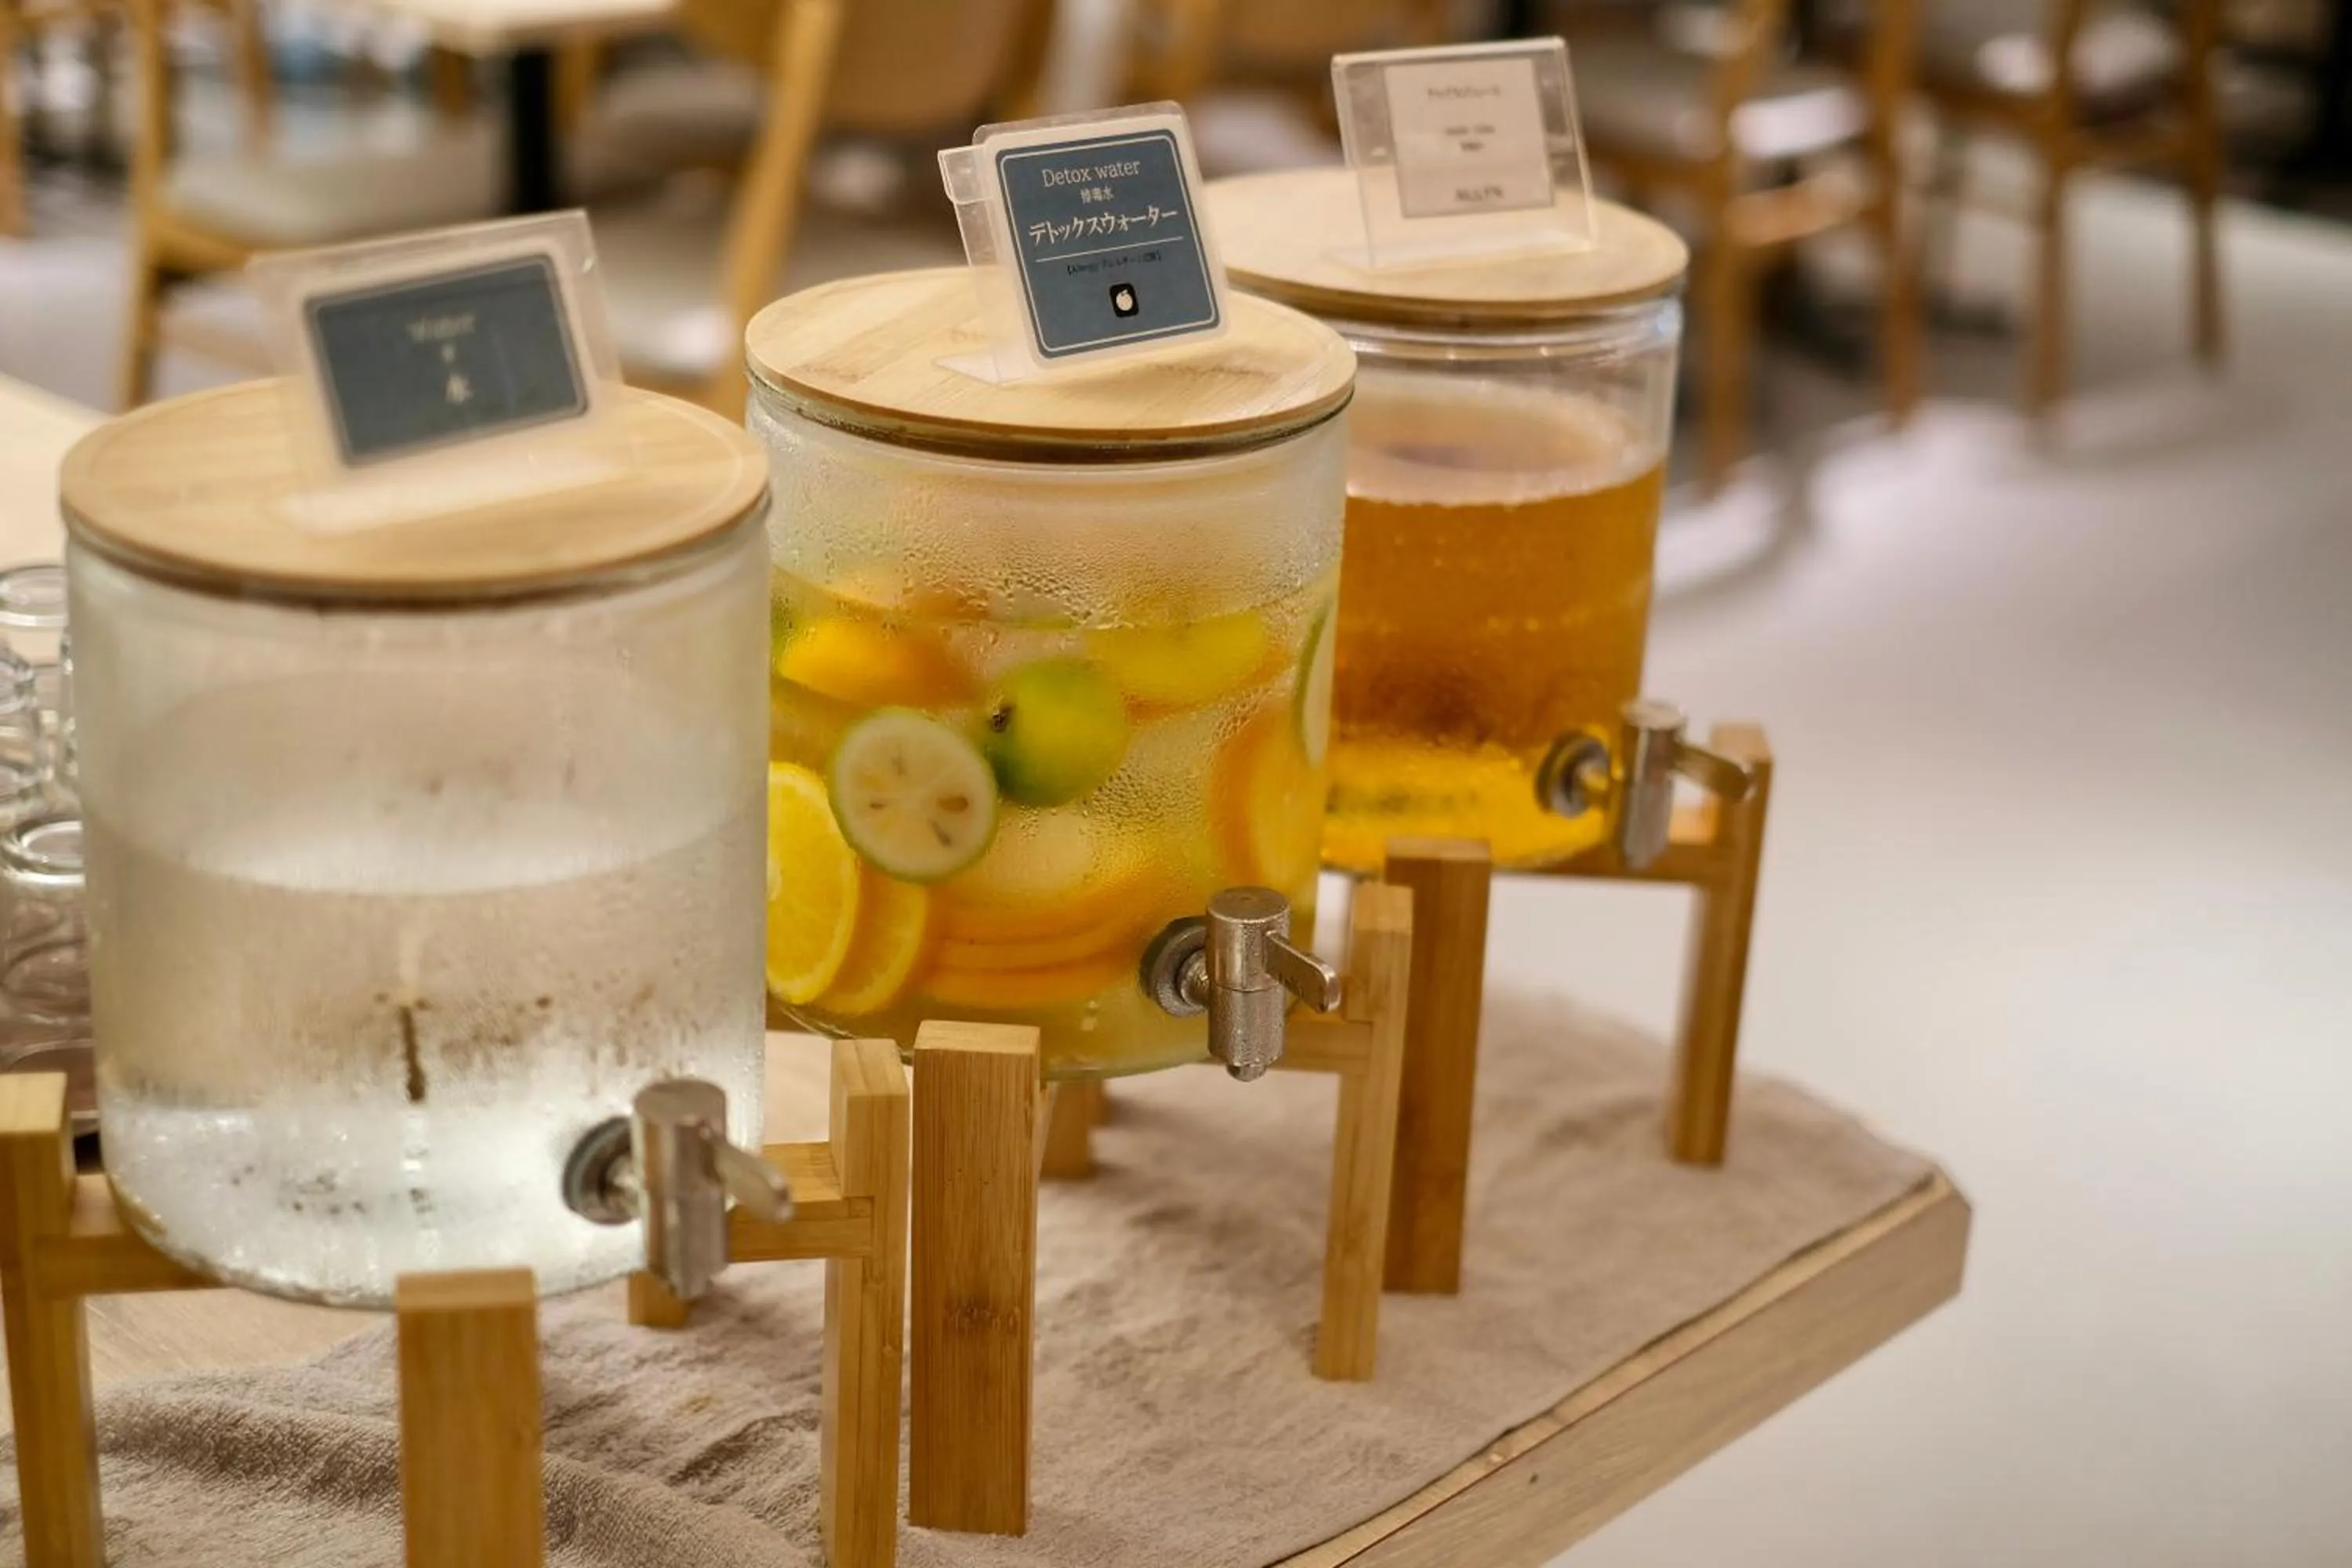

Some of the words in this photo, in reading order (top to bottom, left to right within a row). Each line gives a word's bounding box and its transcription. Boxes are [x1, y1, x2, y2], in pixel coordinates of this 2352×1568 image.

[1042, 167, 1091, 187] Detox
[1094, 161, 1140, 180] water
[1029, 205, 1178, 246] デトックスウォーター
